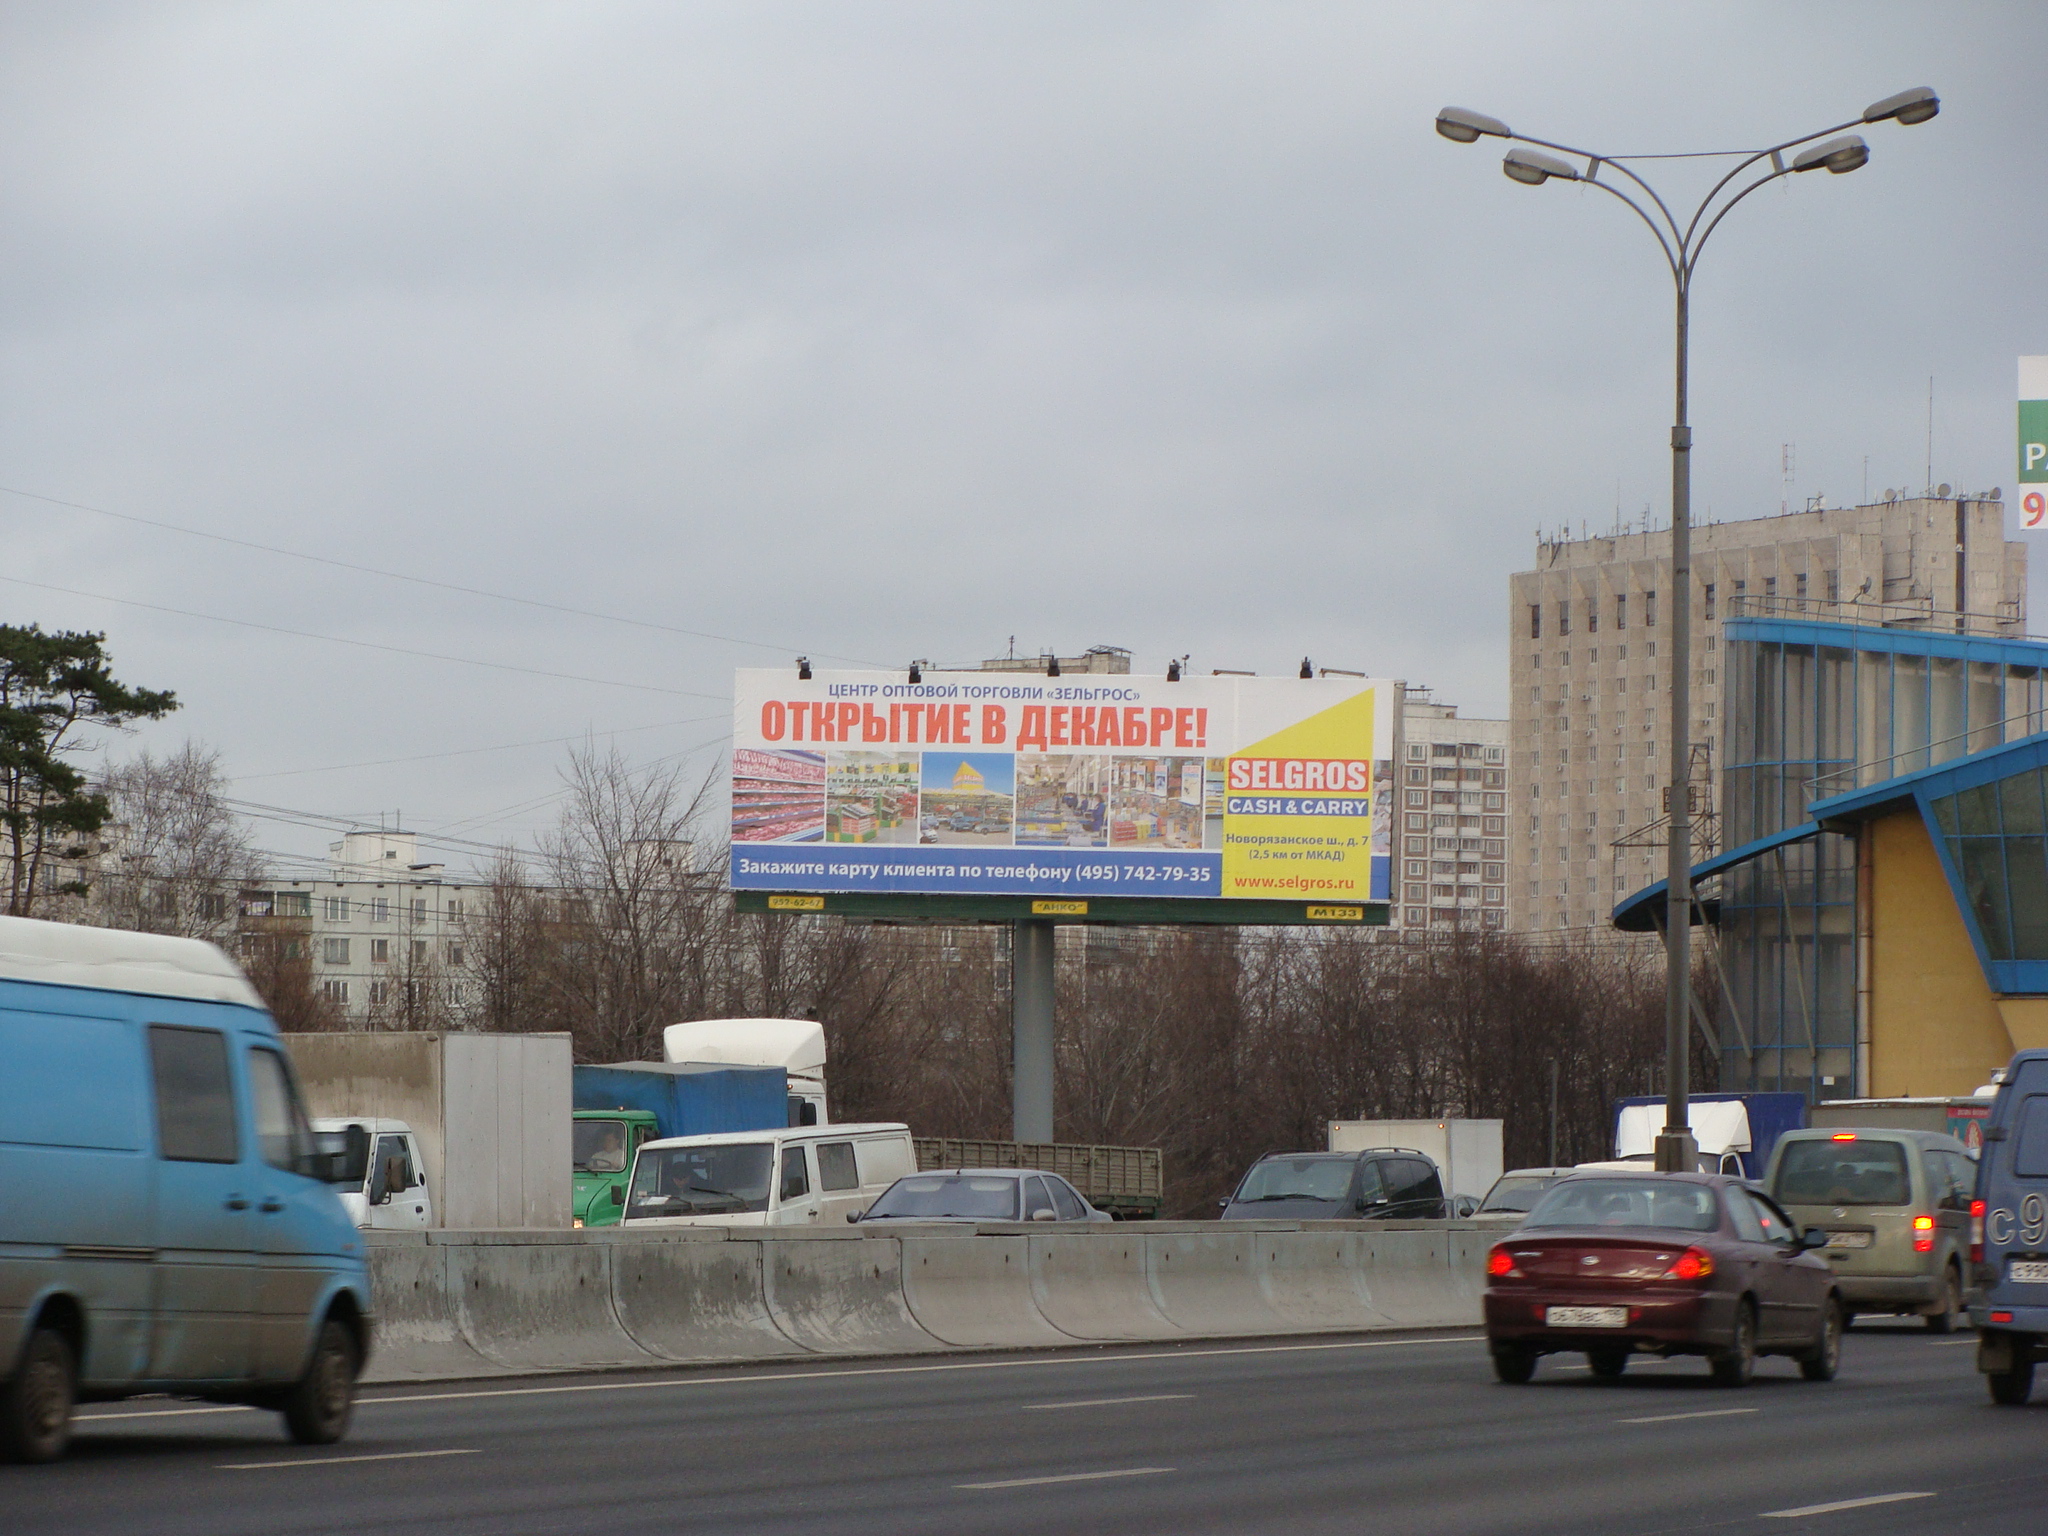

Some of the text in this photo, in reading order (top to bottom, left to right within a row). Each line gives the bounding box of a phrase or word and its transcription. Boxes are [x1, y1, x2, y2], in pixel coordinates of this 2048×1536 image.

[829, 683, 1141, 701] ЦЕНТР ОПТОВОЙ ТОРГОВЛИ «ЗЕЛЬГРОС»
[761, 700, 1208, 752] ОТКРЫТИЕ В ДЕКАБРЕ!
[1230, 759, 1367, 791] SELGROS
[1228, 798, 1367, 815] CASH & CARRY
[1225, 833, 1369, 848] Новорязанское ш., д. 7
[1249, 849, 1345, 862] (2,5 км от МКАД)
[739, 858, 1211, 882] Закажите карту клиента по телефону (495) 742-79-35
[1234, 875, 1355, 892] www.selgros.ru
